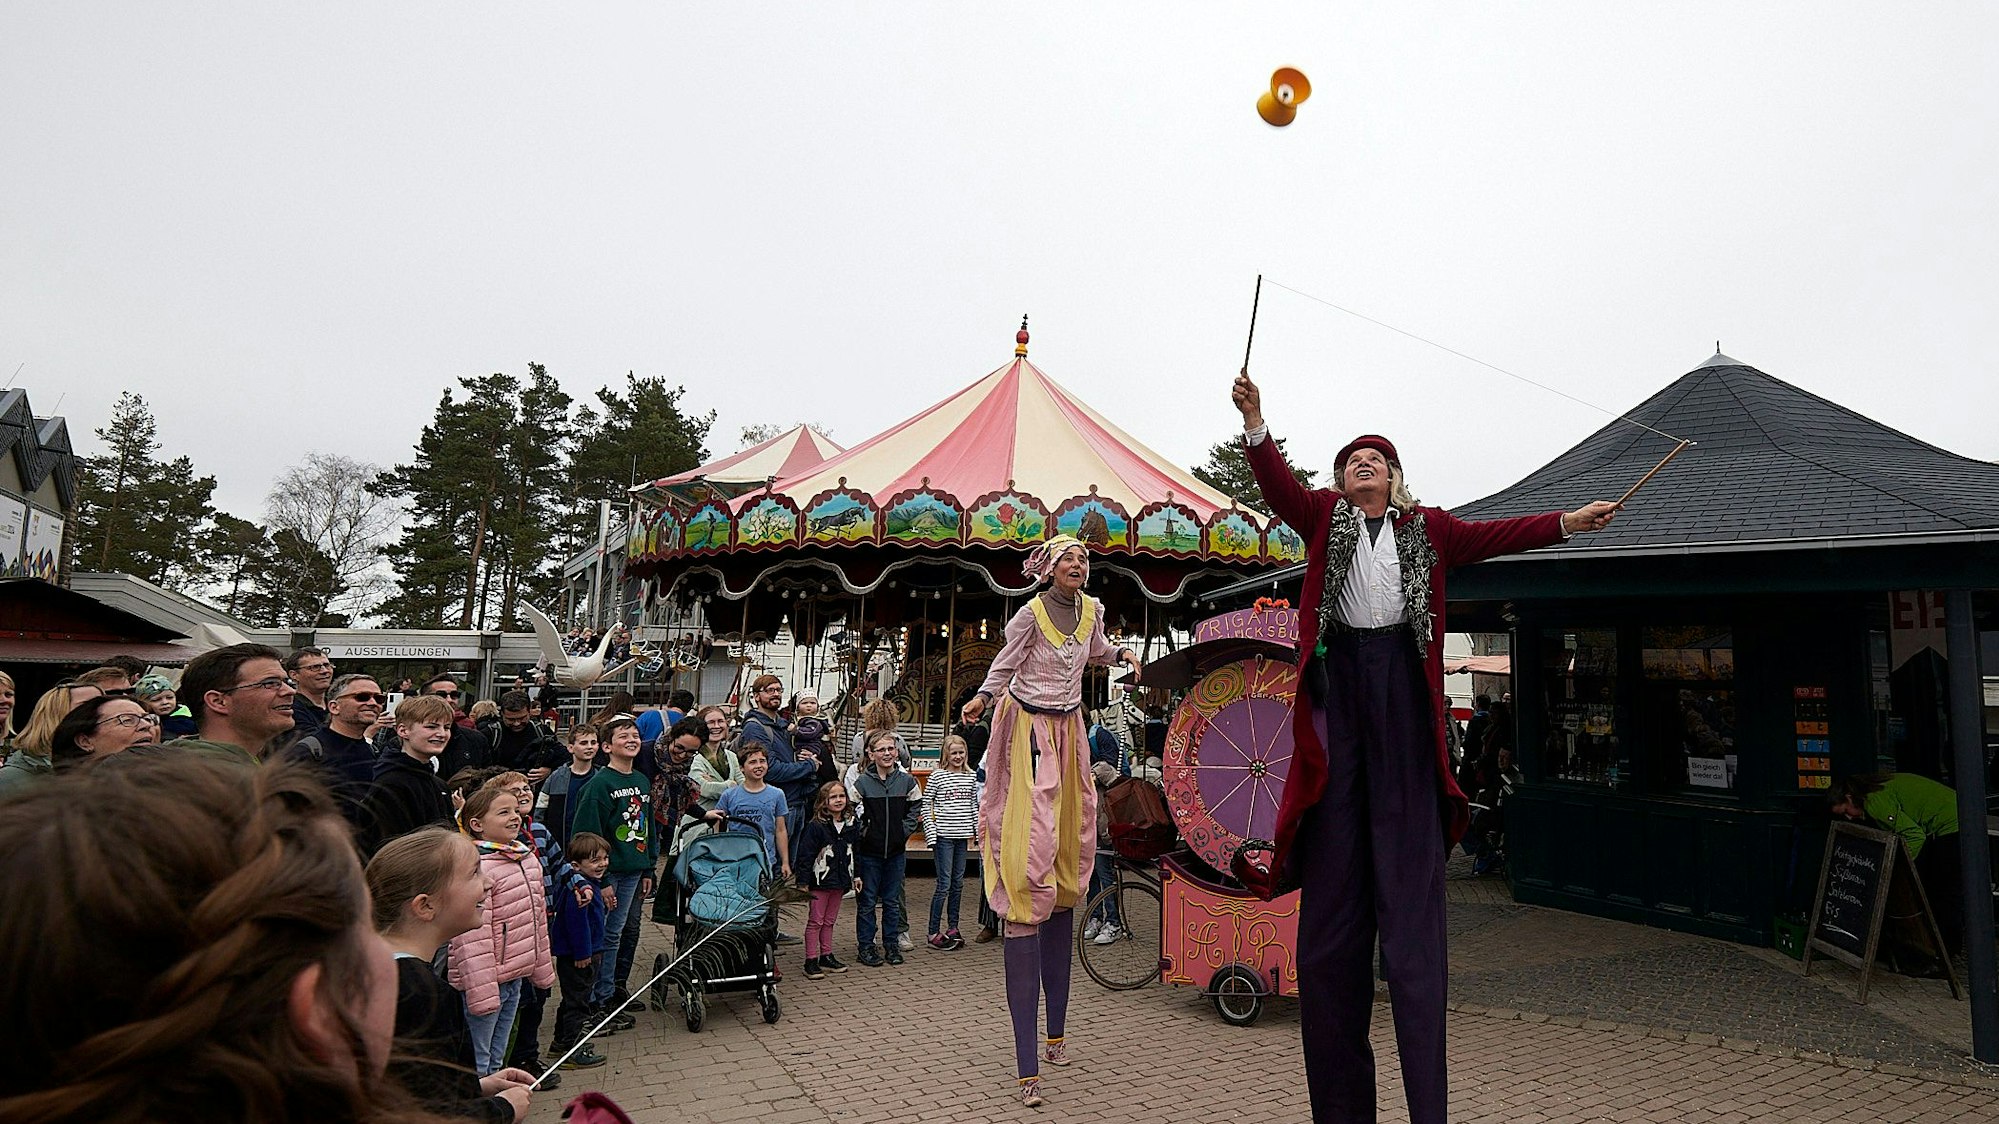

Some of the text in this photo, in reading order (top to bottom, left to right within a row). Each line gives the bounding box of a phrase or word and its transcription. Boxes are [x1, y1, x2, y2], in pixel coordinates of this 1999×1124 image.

[1209, 610, 1299, 637] RIGATON
[345, 647, 451, 657] AUSSTELLUNGEN
[610, 787, 641, 800] MARIO &
[1825, 901, 1840, 919] Eis
